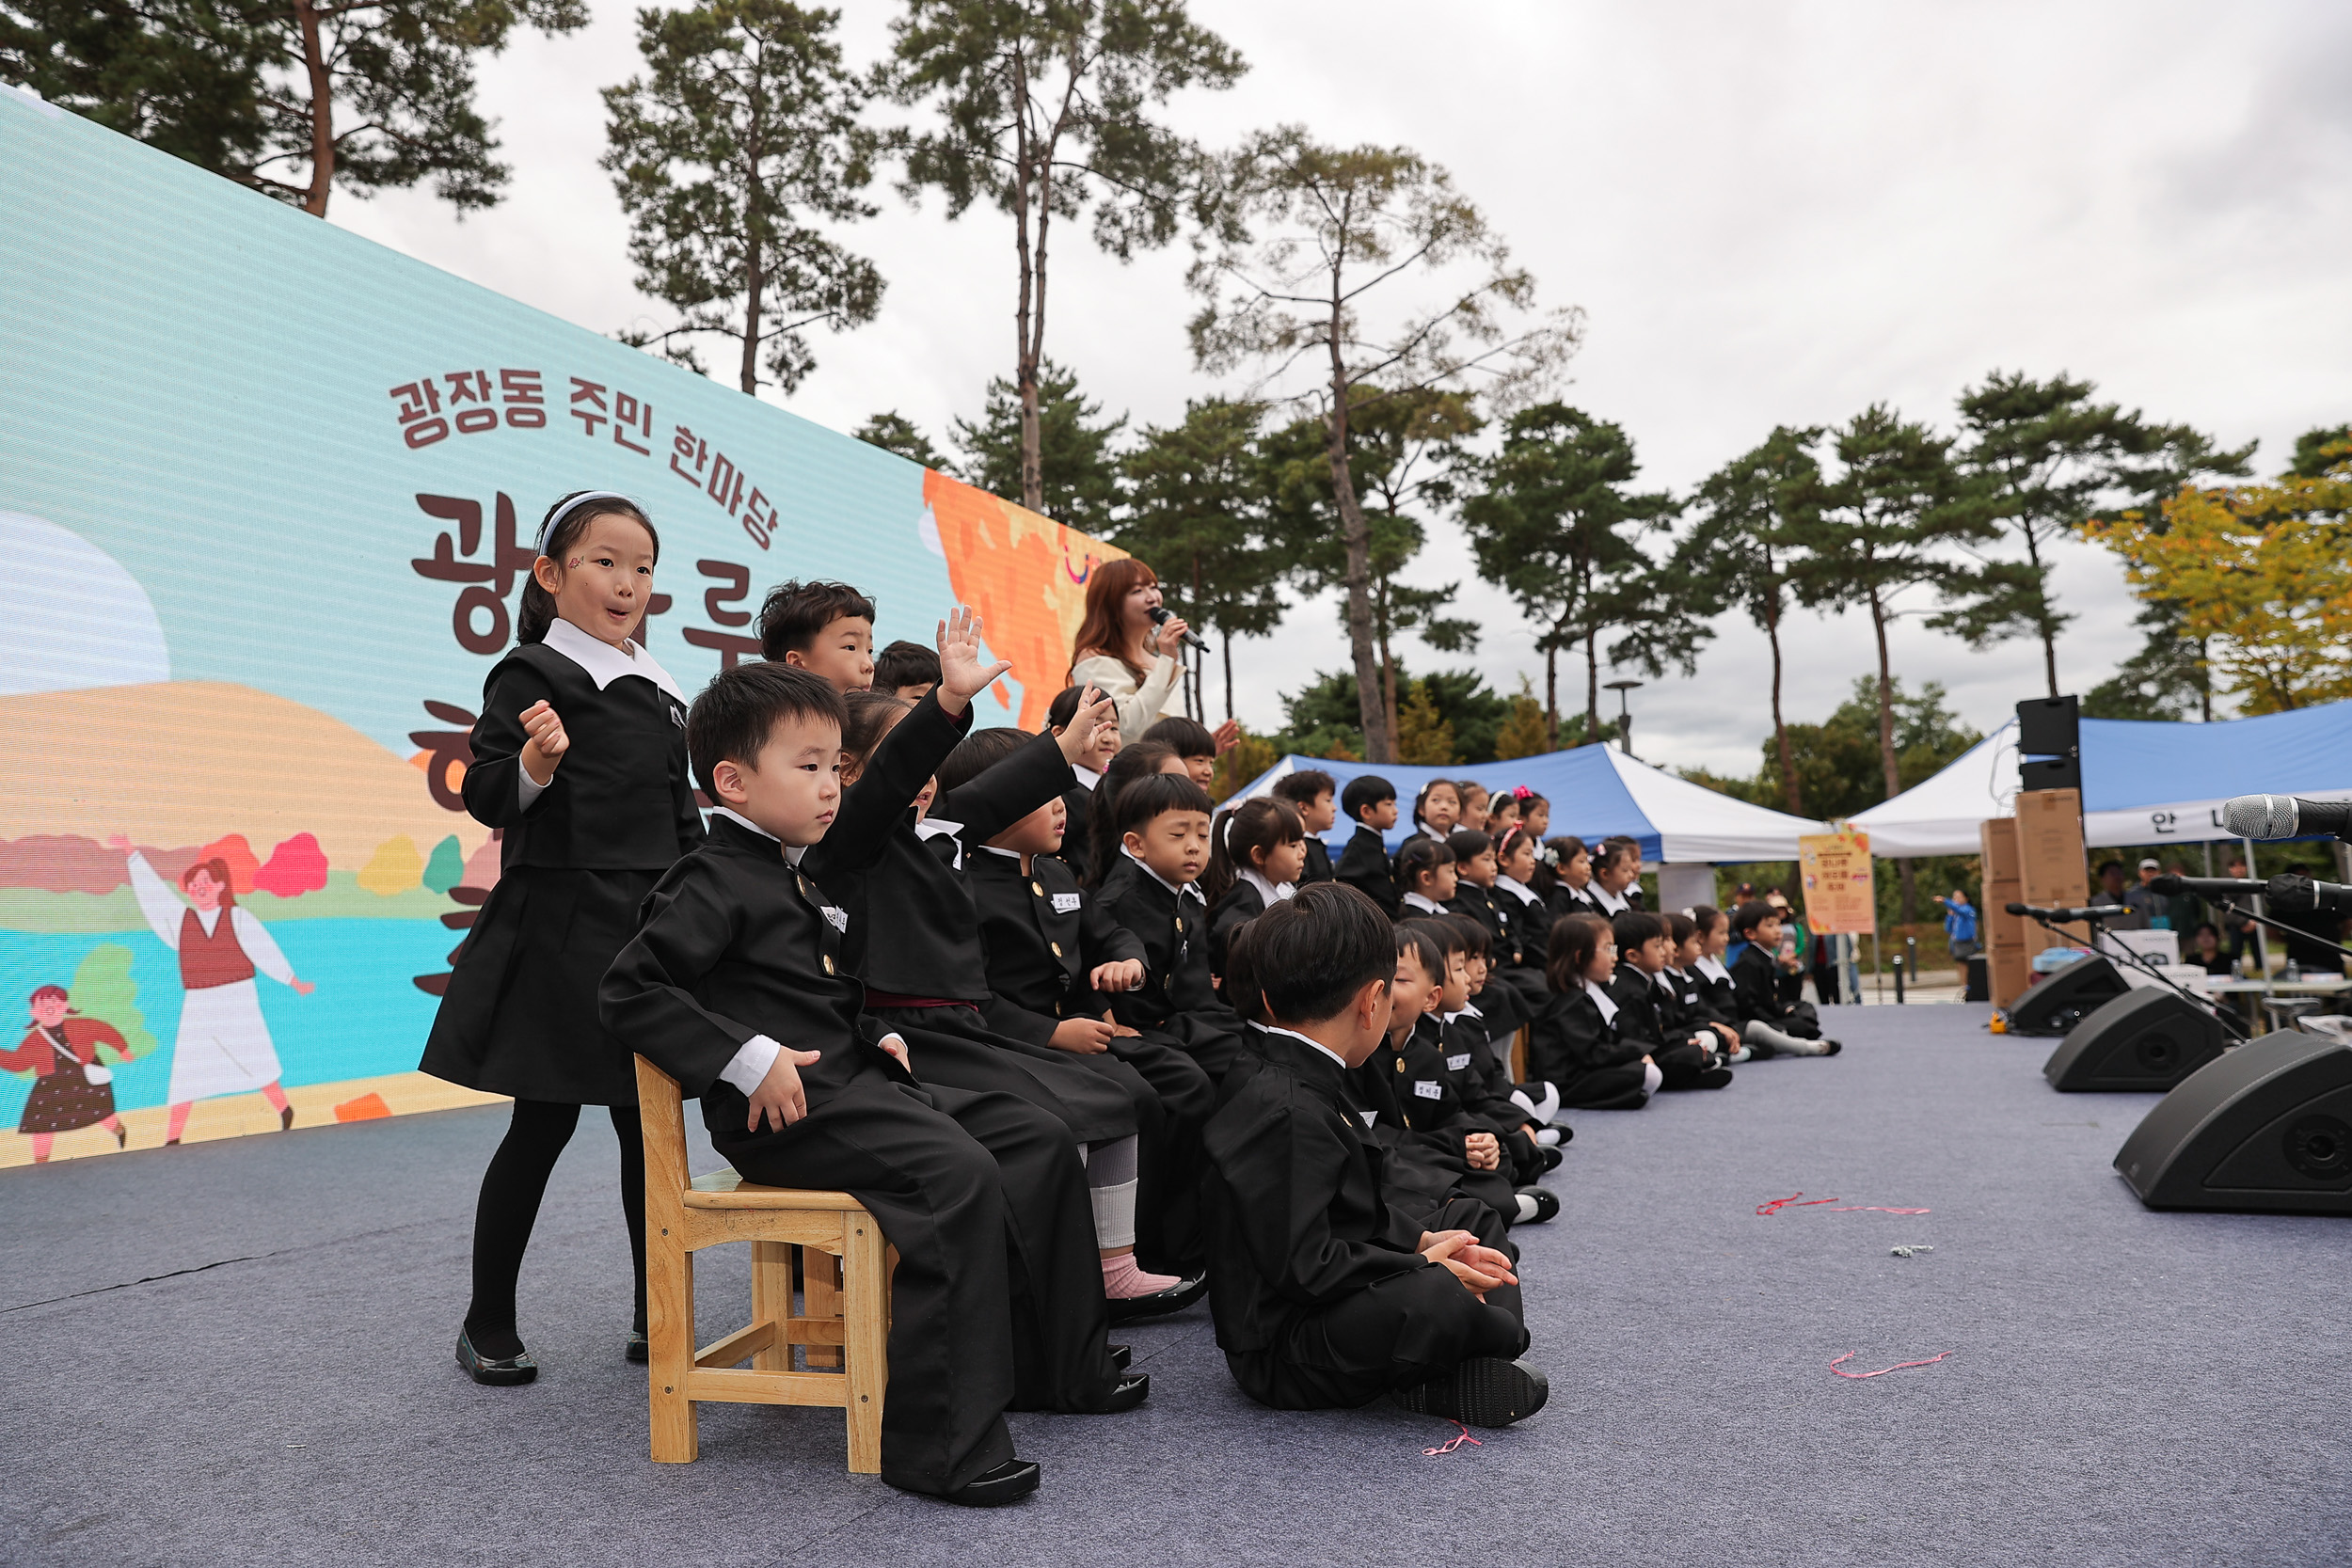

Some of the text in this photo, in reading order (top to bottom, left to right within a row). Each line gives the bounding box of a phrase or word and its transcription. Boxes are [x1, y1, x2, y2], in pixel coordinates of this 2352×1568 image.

[389, 368, 779, 551] 광장동 주민 한마당
[410, 490, 765, 670] 광루
